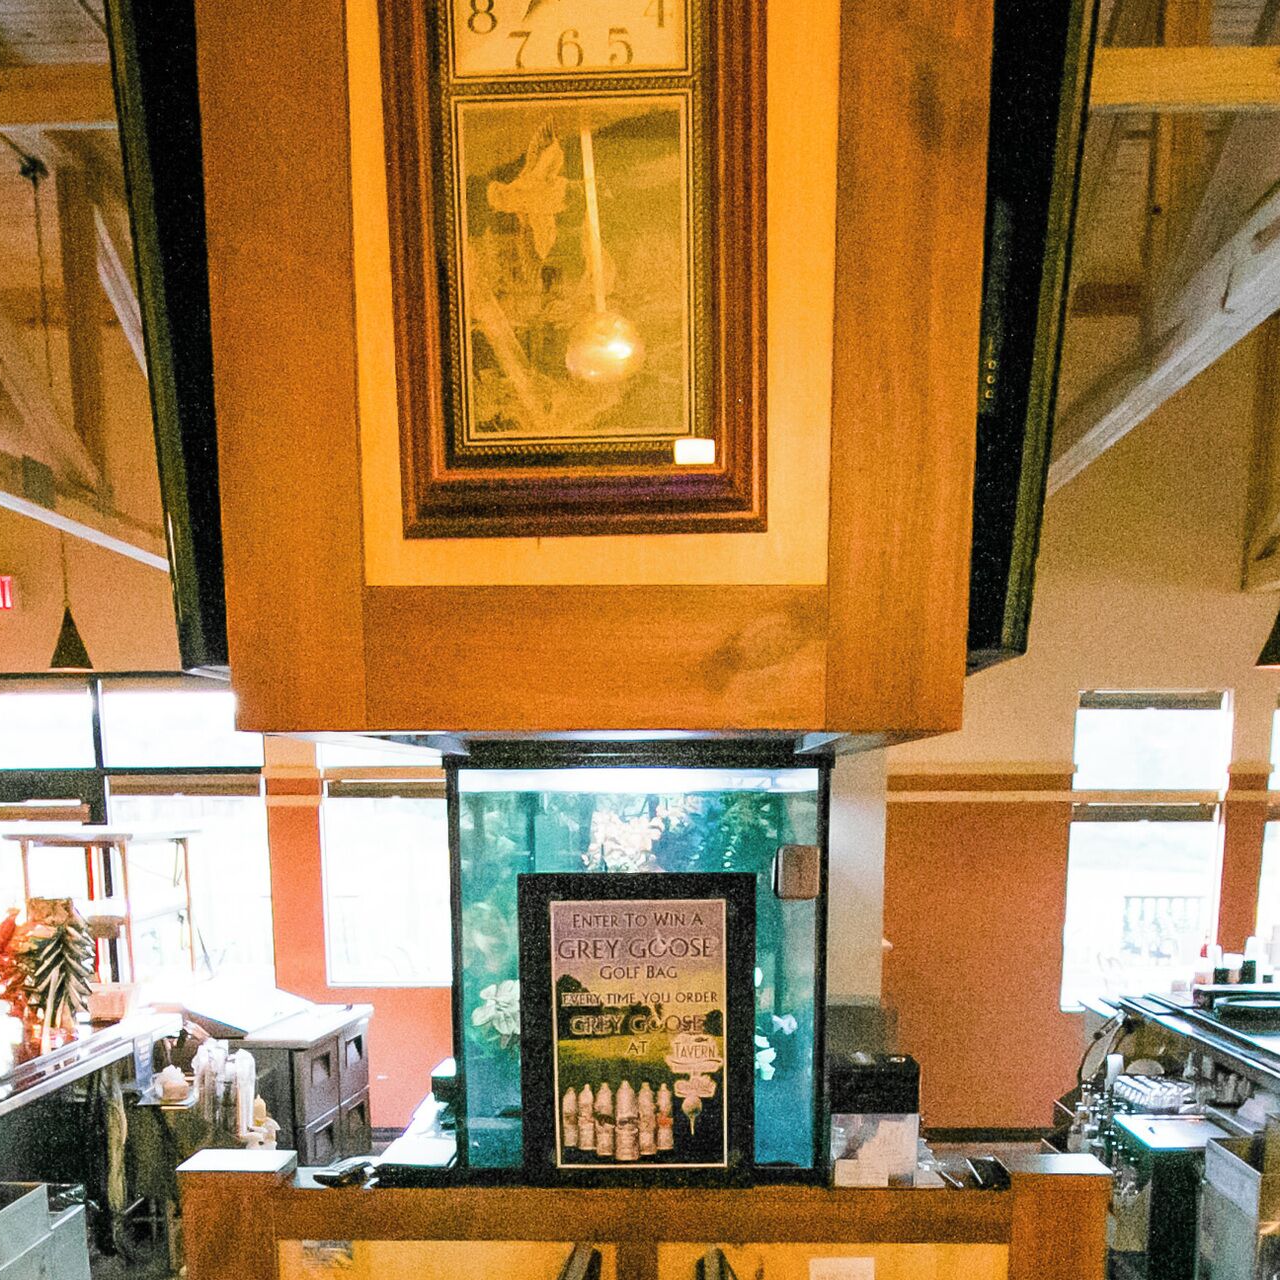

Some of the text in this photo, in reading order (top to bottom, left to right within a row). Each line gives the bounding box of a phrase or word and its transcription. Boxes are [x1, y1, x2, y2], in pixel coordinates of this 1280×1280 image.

[467, 0, 497, 35] 8
[507, 27, 634, 69] 7 6 5
[572, 912, 704, 929] ENTER TO WIN A
[557, 937, 714, 960] GREY GOOSE
[599, 965, 678, 980] GOLF BAG
[561, 991, 718, 1006] EVERY TIME YOU ORDER
[571, 1014, 706, 1036] GREY GOOSE
[627, 1040, 649, 1055] AT
[673, 1042, 716, 1060] TAVERN
